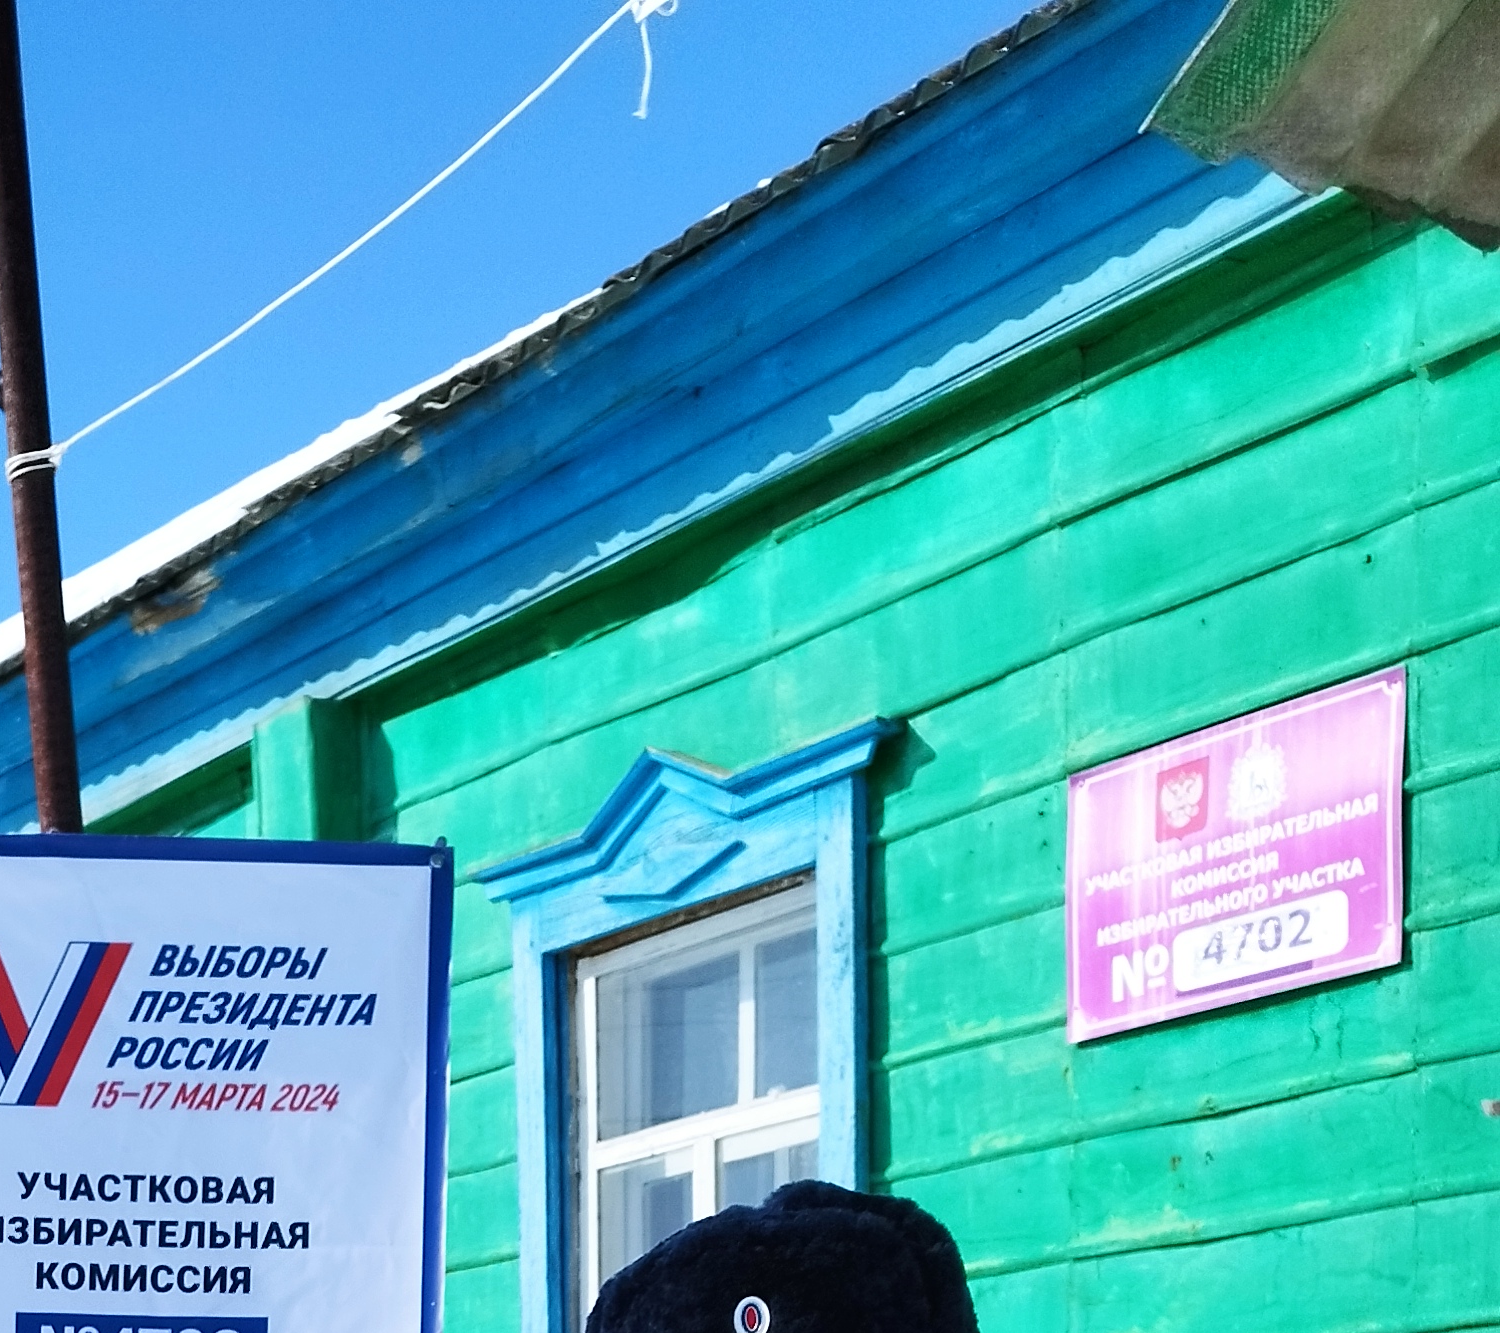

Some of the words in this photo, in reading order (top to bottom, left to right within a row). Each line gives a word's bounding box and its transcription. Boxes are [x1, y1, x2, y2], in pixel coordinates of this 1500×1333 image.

[1085, 845, 1202, 896] УЧАСТКОВАЯ
[1207, 793, 1379, 859] ИЗБИРАТЕЛЬНАЯ
[1171, 851, 1279, 898] КОМИССИЯ
[1097, 883, 1268, 947] ИЗБИРАТЕЛЬНОГО
[1273, 857, 1365, 902] УЧАСТКА
[1203, 908, 1313, 966] 4702
[150, 944, 327, 979] ВЫБОРЫ
[129, 992, 377, 1029] ПРЕЗИДЕНТА
[107, 1037, 269, 1071] РОССИИ
[172, 1083, 264, 1111] МАРТА
[271, 1084, 339, 1112] 2024
[18, 1172, 275, 1204] УЧАСТКОВАЯ
[36, 1262, 252, 1293] КОМИССИЯ
